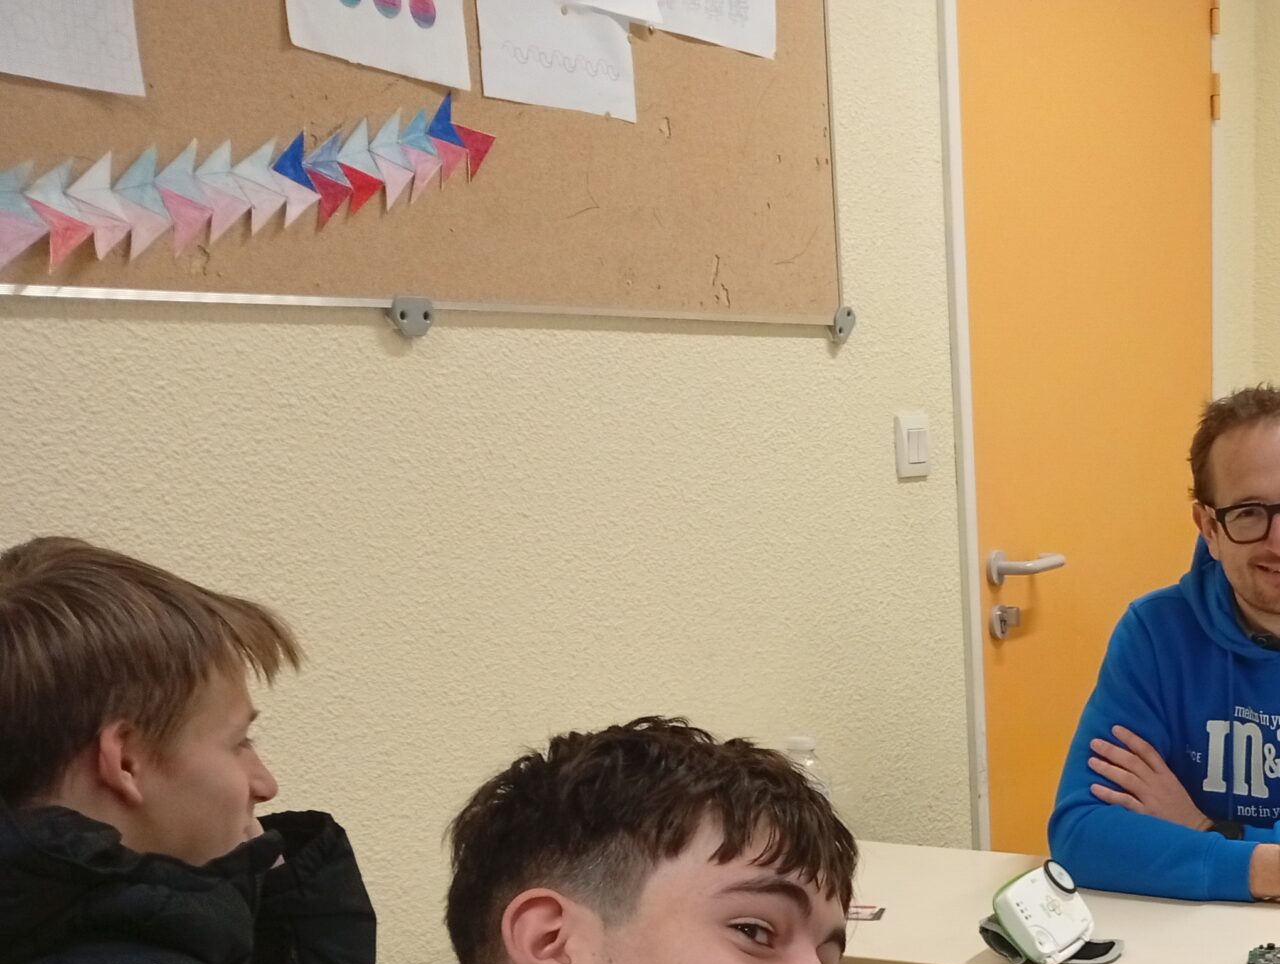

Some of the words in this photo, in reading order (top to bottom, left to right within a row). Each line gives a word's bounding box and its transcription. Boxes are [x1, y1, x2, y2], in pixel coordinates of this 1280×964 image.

[1259, 710, 1270, 726] in
[1237, 805, 1258, 817] not
[1259, 805, 1271, 818] in
